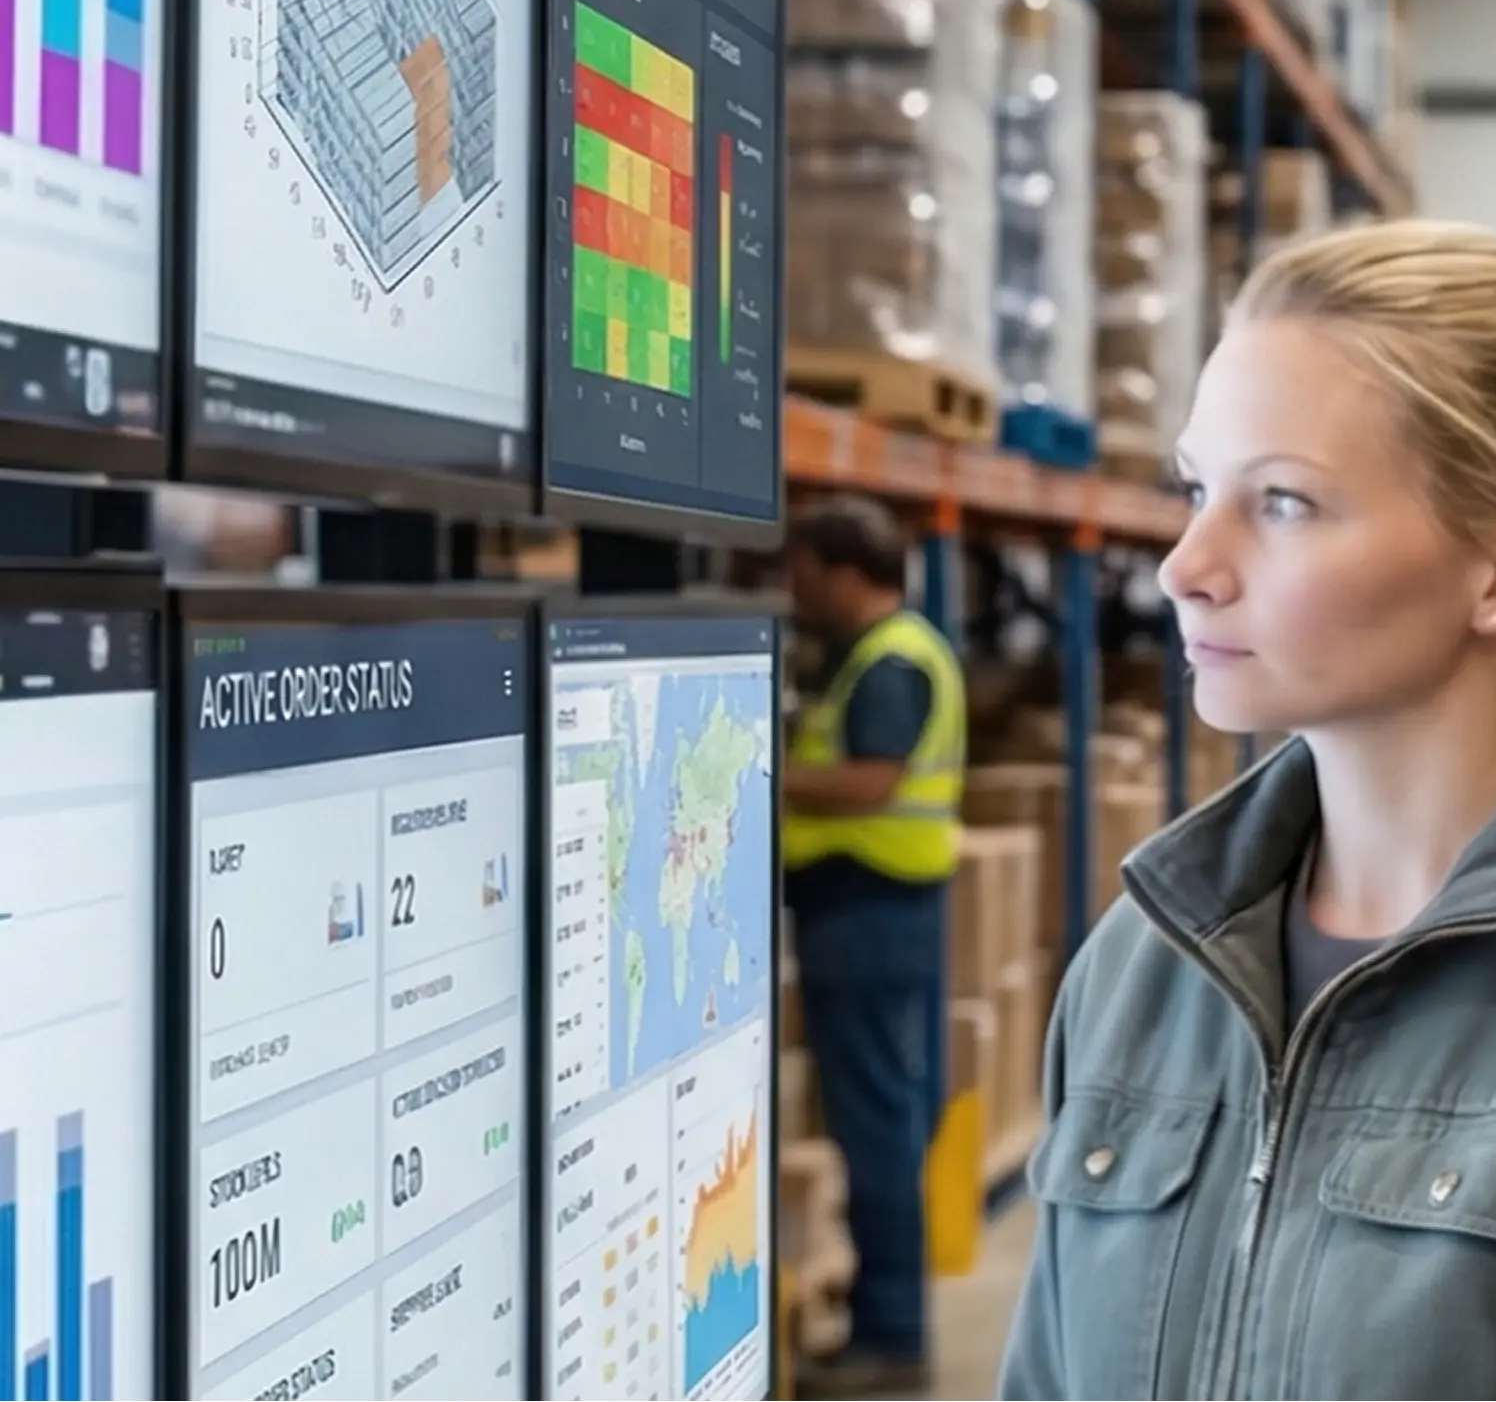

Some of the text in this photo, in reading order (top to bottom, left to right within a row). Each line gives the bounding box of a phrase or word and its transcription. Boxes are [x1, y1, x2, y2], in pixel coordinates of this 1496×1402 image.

[199, 658, 413, 730] ACTIVE ORDER STATUS
[390, 874, 416, 928] 22
[209, 1217, 281, 1309] 100M
